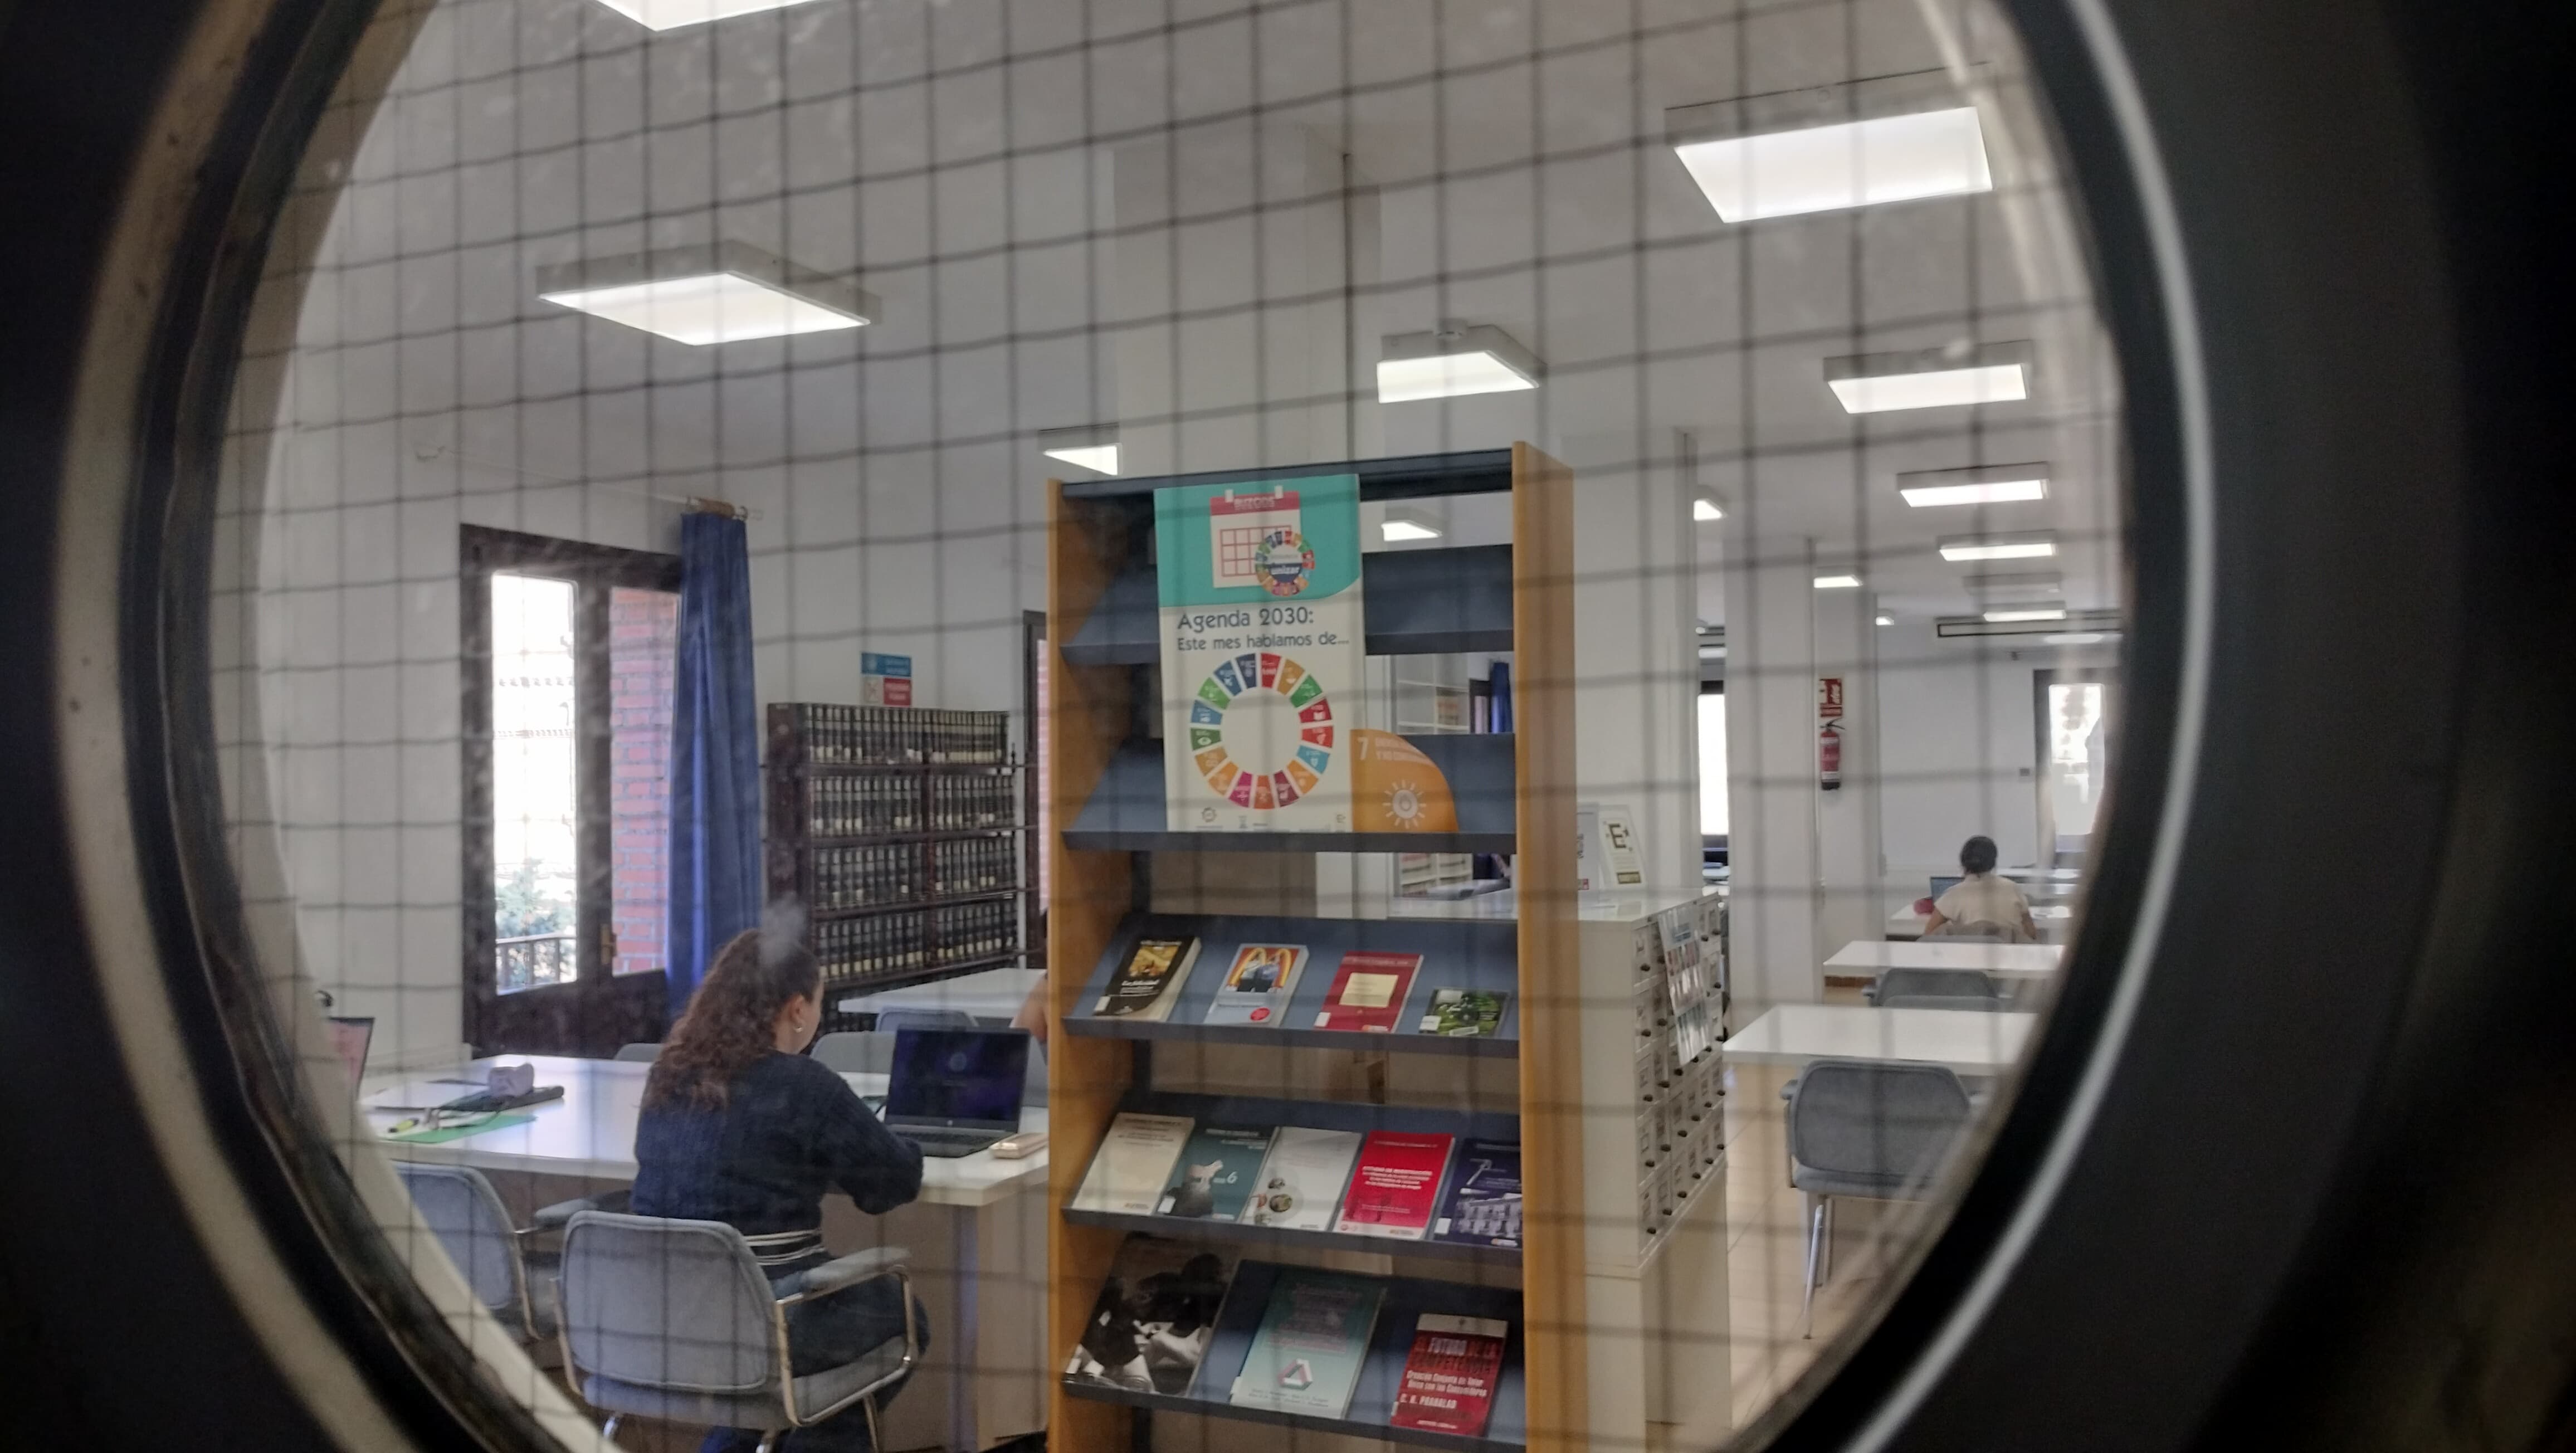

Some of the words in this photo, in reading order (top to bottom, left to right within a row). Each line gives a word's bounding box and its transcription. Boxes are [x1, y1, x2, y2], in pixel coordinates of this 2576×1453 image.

[1177, 610, 1251, 633] Agenda
[1258, 606, 1314, 626] 2030:
[1177, 637, 1207, 651] Este
[1213, 637, 1241, 650] mes
[1246, 633, 1313, 649] hablamos
[1358, 737, 1369, 760] 7
[1227, 1171, 1238, 1184] 6
